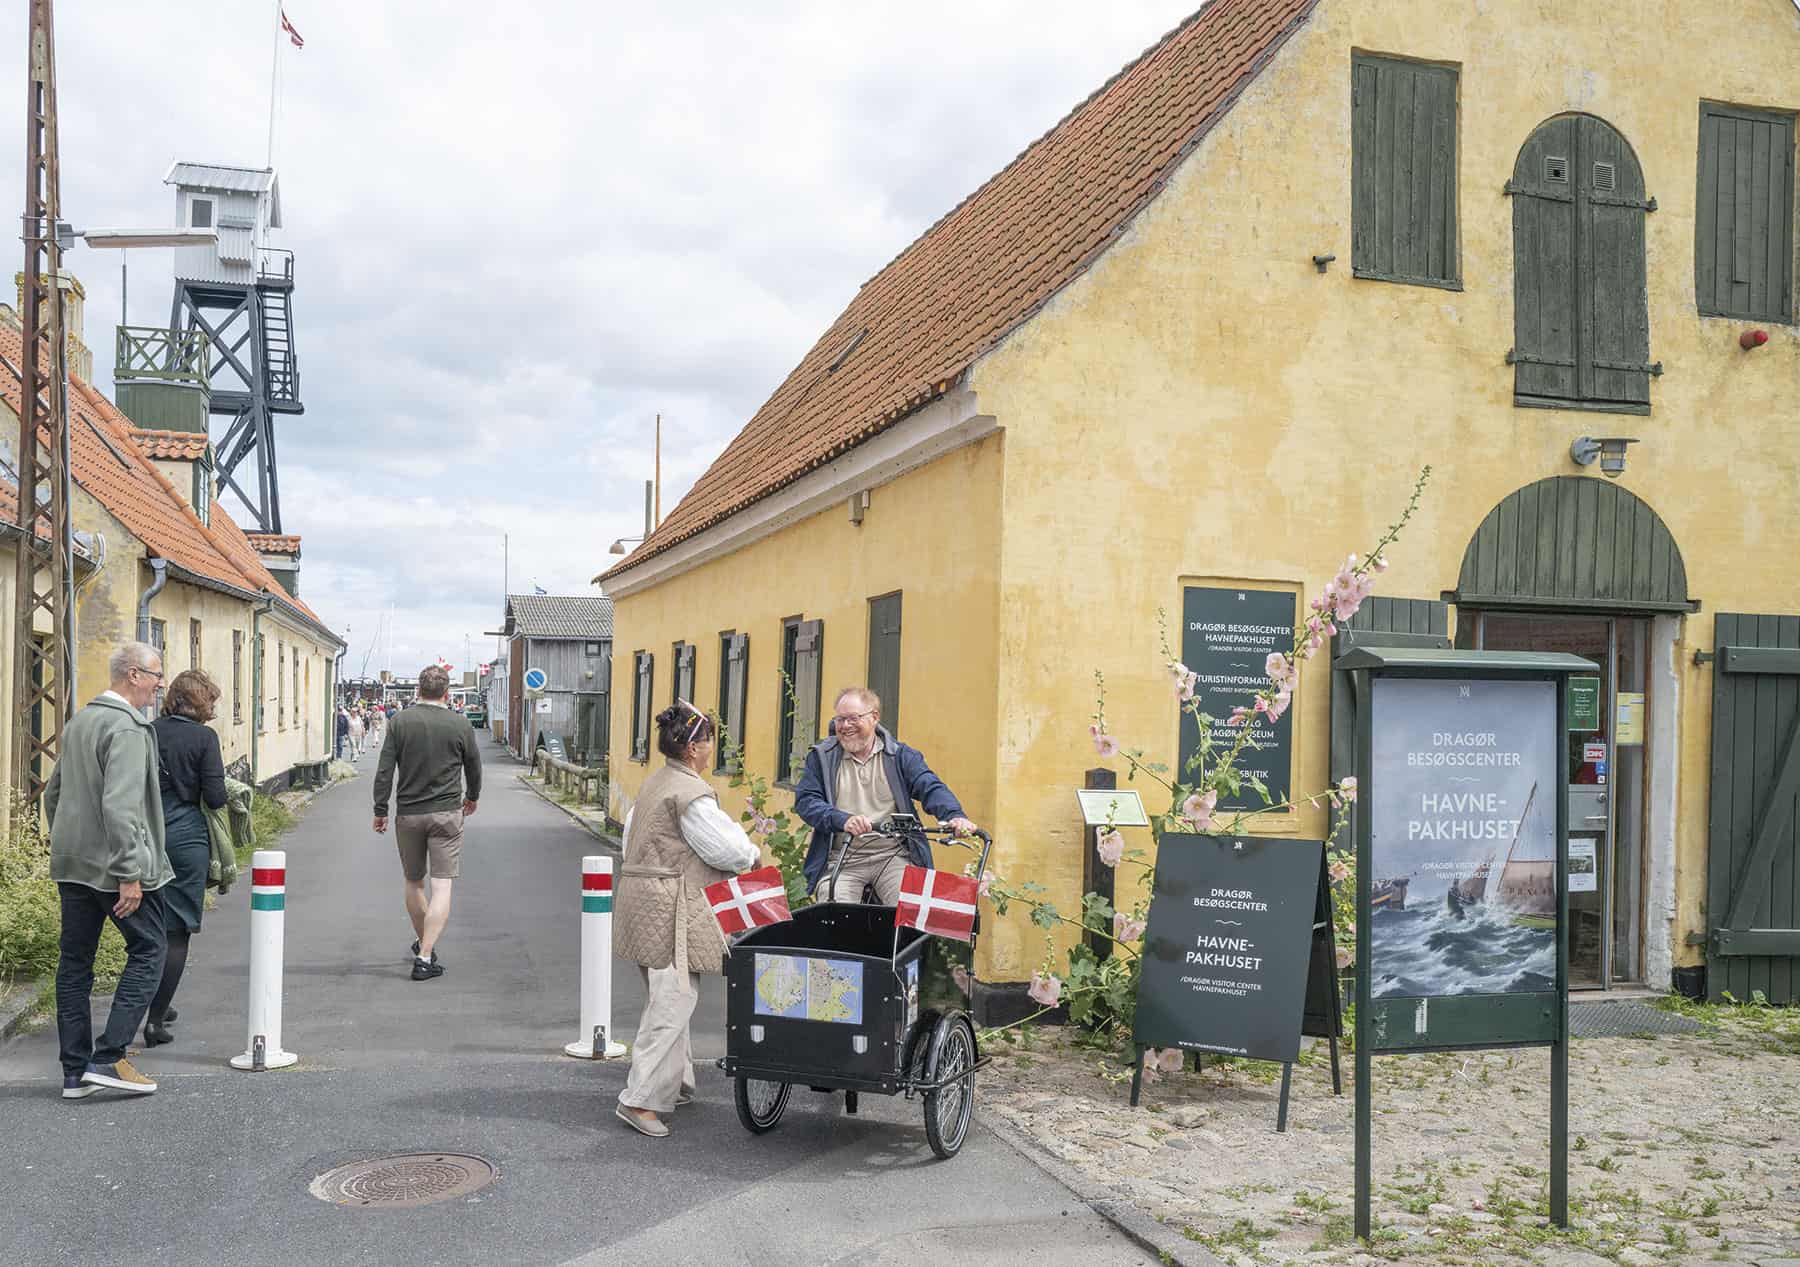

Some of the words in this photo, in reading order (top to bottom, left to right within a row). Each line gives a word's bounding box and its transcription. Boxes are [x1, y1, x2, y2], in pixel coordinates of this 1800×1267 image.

[1190, 622, 1226, 632] DRAGØR
[1228, 625, 1290, 635] BESØGSCENTER
[1205, 634, 1275, 645] HAVNEPAKHUSET
[1432, 733, 1496, 746] DRAGØR
[1407, 752, 1521, 767] BESØGSCENTER
[1422, 793, 1507, 813] HAVNE-
[1408, 820, 1521, 840] PAKHUSET
[1211, 888, 1253, 900] DRAGØR
[1193, 897, 1268, 912] BESØGSCENTER
[1197, 935, 1255, 952] HAVNE-
[1186, 952, 1262, 971] PAKHUSET
[1192, 985, 1247, 996] HAVNEPAKHUSET
[1212, 979, 1236, 987] VISITOR
[1236, 982, 1262, 990] CENTER
